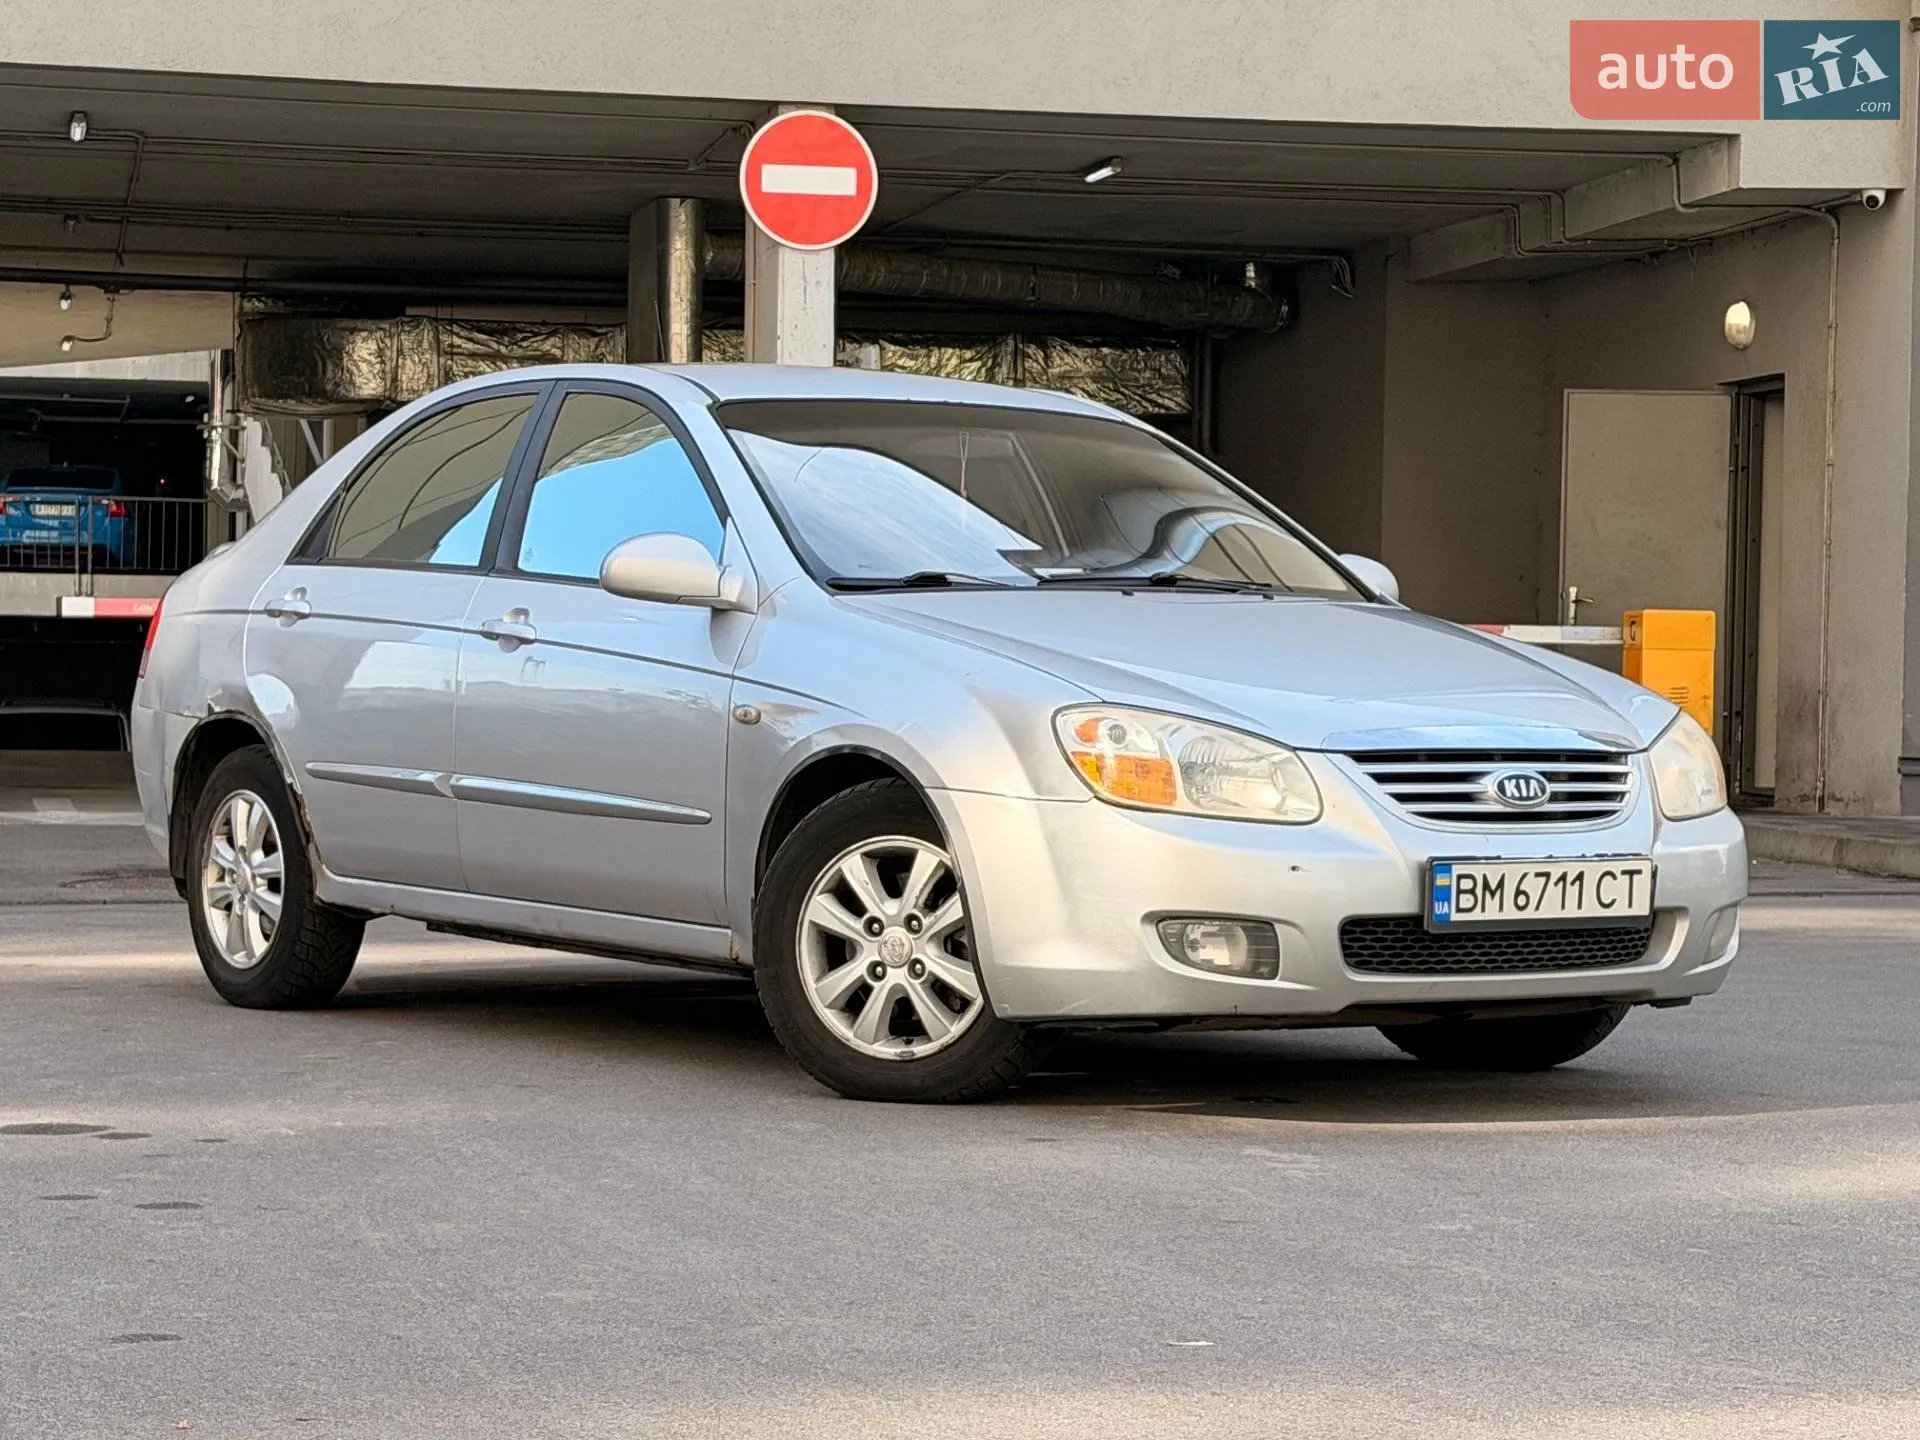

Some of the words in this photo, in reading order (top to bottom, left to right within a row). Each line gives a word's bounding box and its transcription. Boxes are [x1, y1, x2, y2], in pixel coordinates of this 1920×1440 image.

[1502, 778, 1542, 798] KIA
[1455, 872, 1506, 914] BM
[1513, 870, 1585, 912] 6711
[1595, 868, 1643, 910] CT
[1434, 901, 1449, 915] UA
